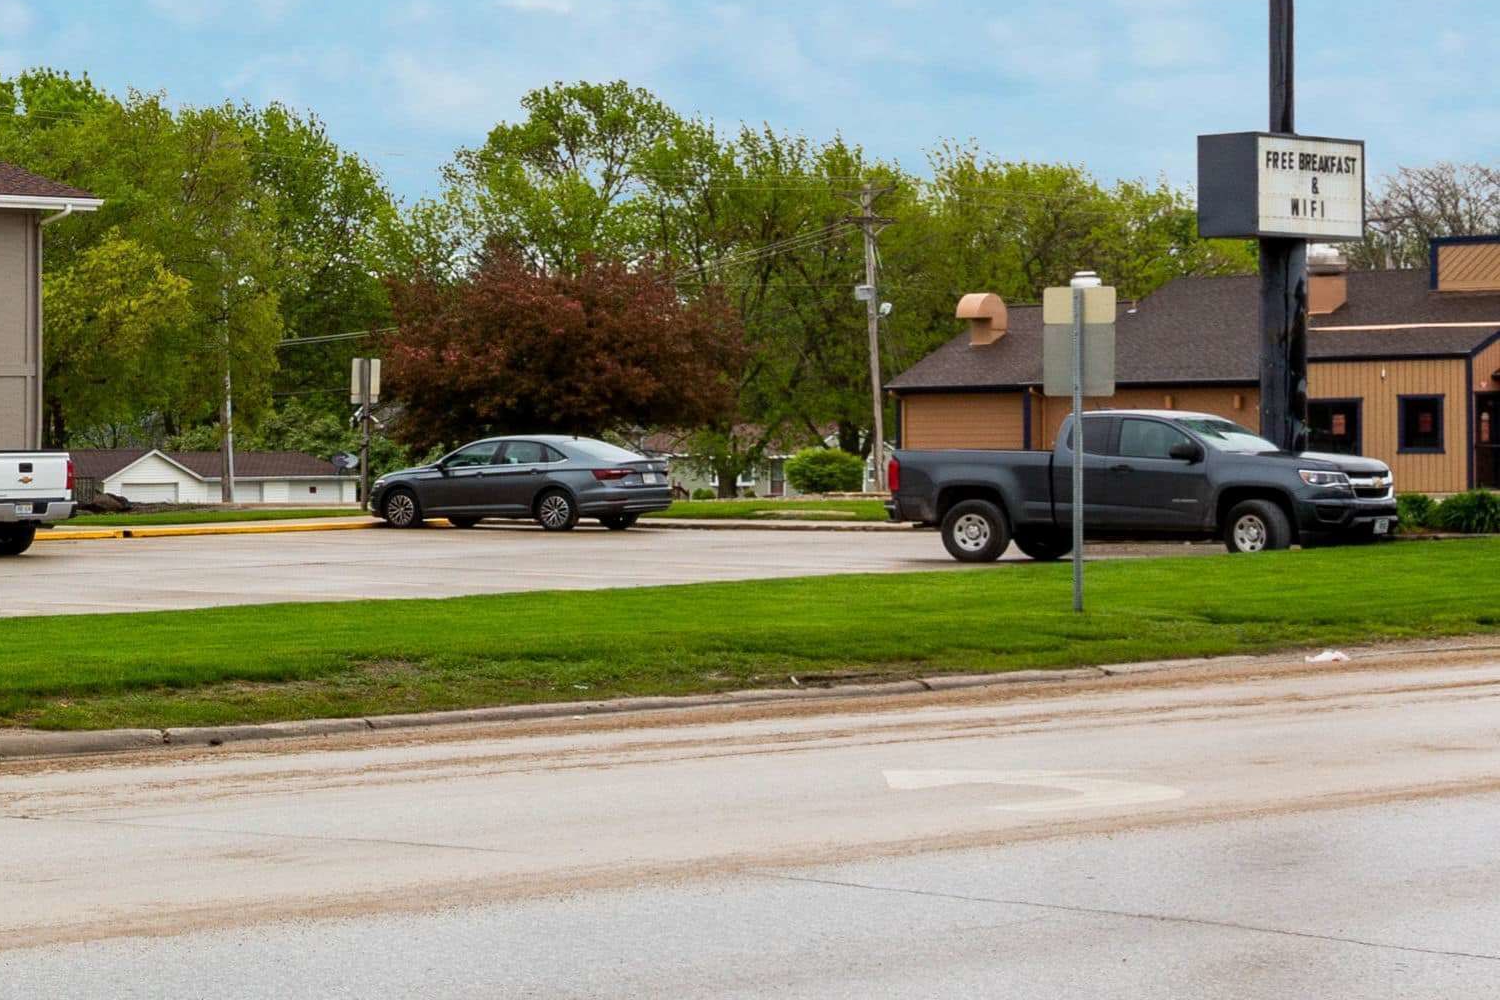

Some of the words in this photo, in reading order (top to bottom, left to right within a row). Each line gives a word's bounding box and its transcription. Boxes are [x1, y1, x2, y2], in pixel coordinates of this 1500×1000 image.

[1265, 150, 1295, 170] FREE
[1298, 152, 1357, 175] BREAKFAST
[1311, 176, 1320, 195] &
[1291, 198, 1325, 218] WIFI
